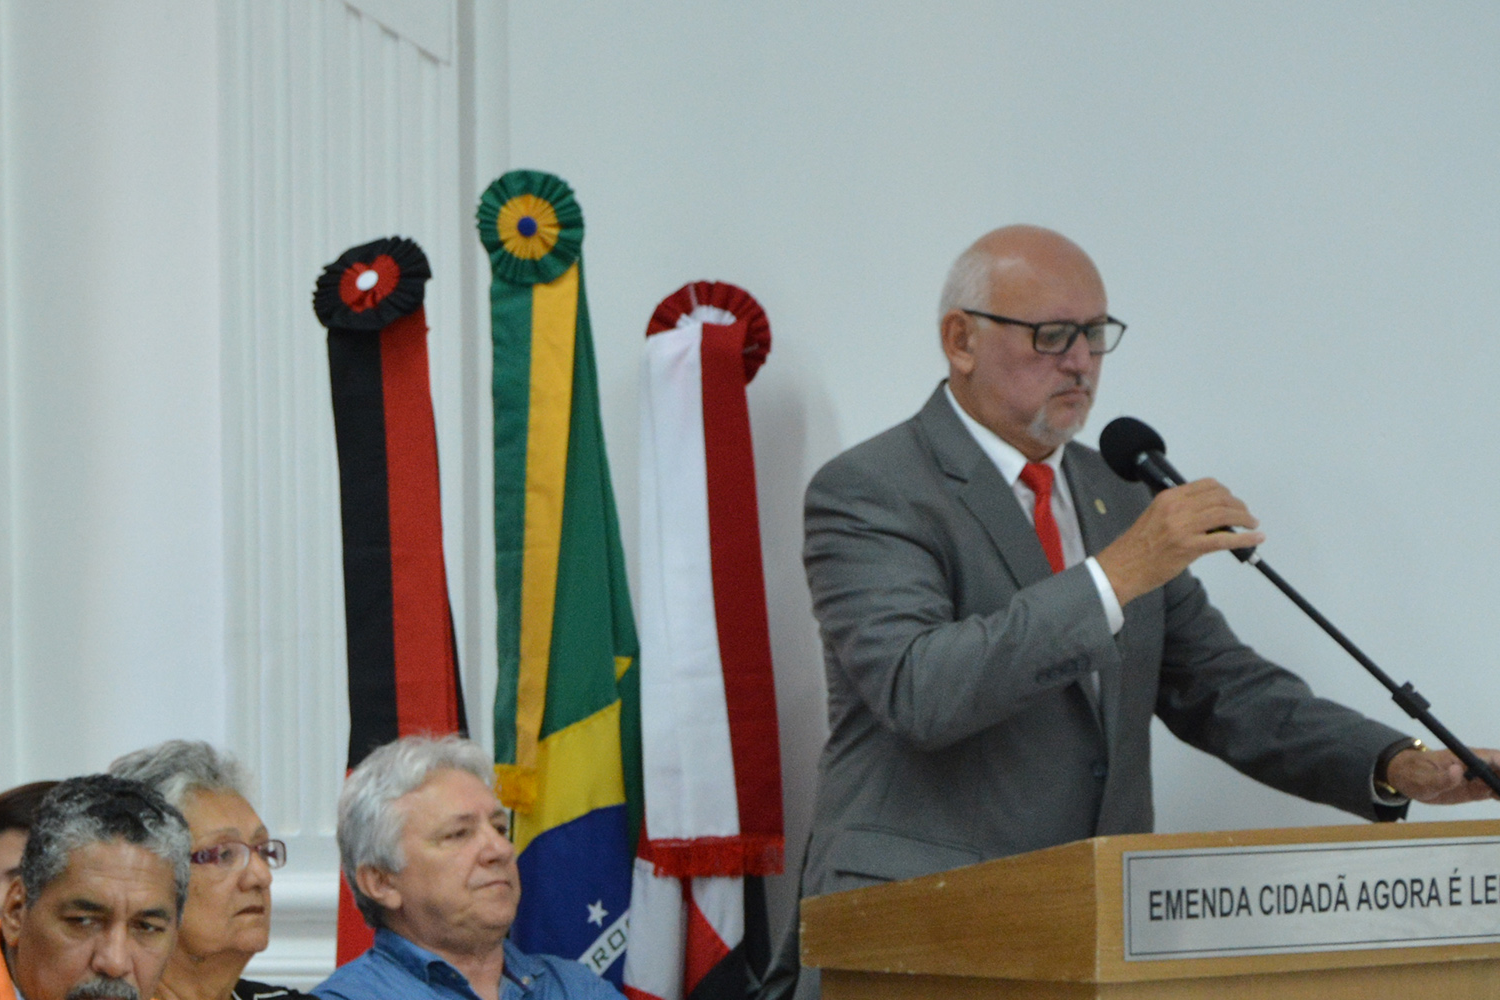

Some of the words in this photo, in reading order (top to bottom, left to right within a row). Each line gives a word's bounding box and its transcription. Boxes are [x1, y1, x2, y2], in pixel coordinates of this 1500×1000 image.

[1149, 885, 1252, 921] EMENDA
[1259, 874, 1350, 915] CIDADÃ
[1356, 876, 1442, 910] AGORA
[1448, 867, 1462, 906] É
[585, 918, 630, 970] RO
